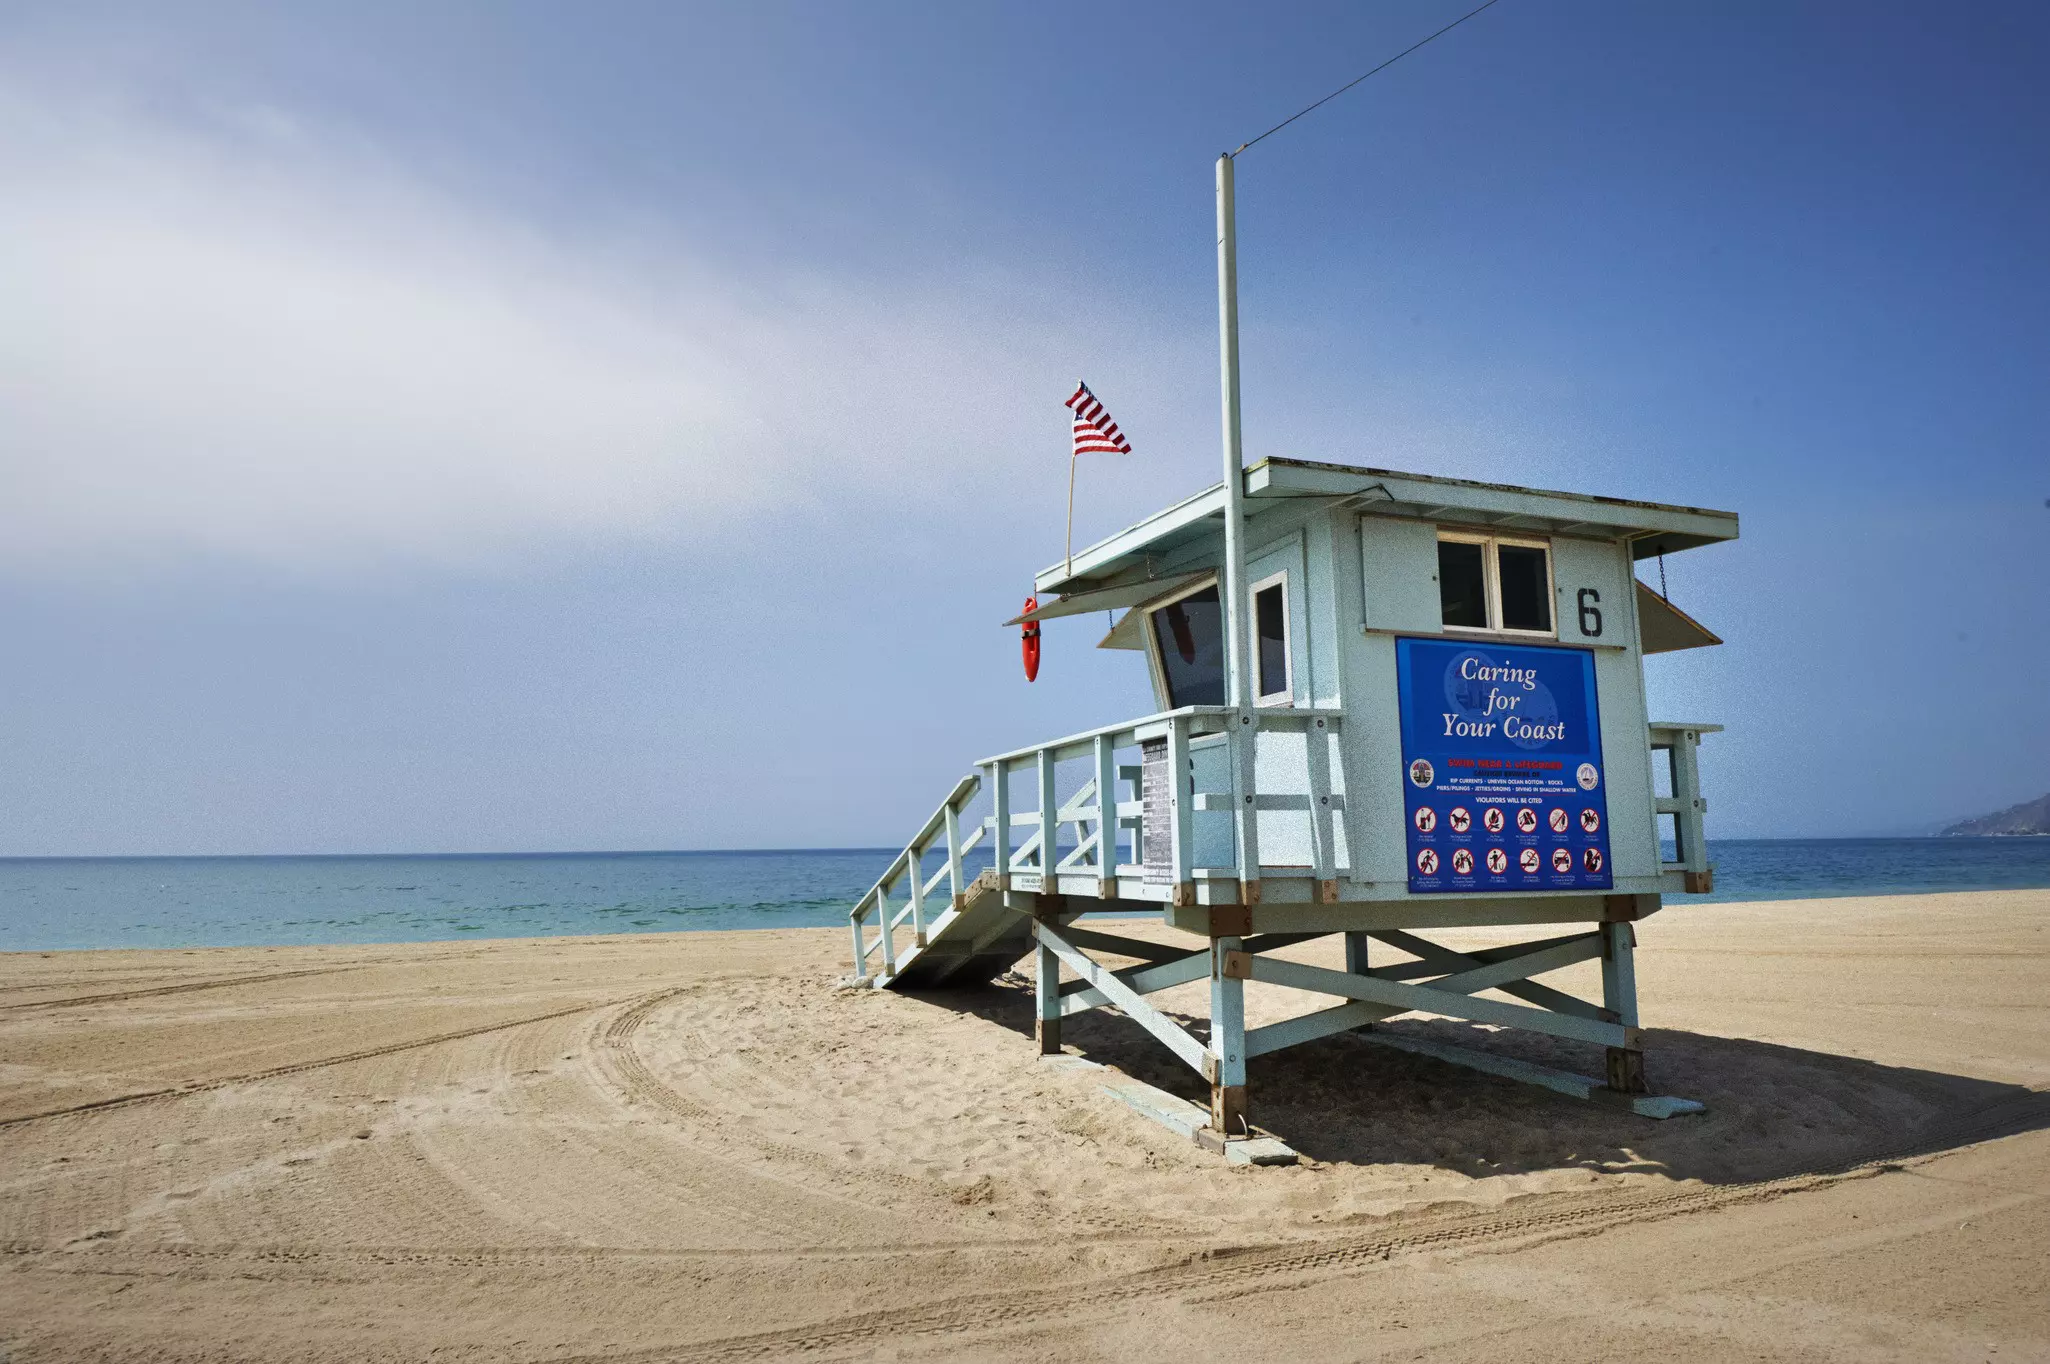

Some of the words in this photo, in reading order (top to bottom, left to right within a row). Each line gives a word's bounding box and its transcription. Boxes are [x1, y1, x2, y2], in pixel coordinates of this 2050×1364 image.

[1577, 588, 1603, 637] 6
[1461, 658, 1537, 690] Caring
[1483, 687, 1520, 716] for
[1442, 713, 1497, 737] Your
[1503, 716, 1566, 740] Coast
[1448, 758, 1475, 768] SWIM
[1477, 759, 1502, 769] NEAR
[1505, 760, 1512, 769] A
[1514, 761, 1563, 770] LIFEGUARD
